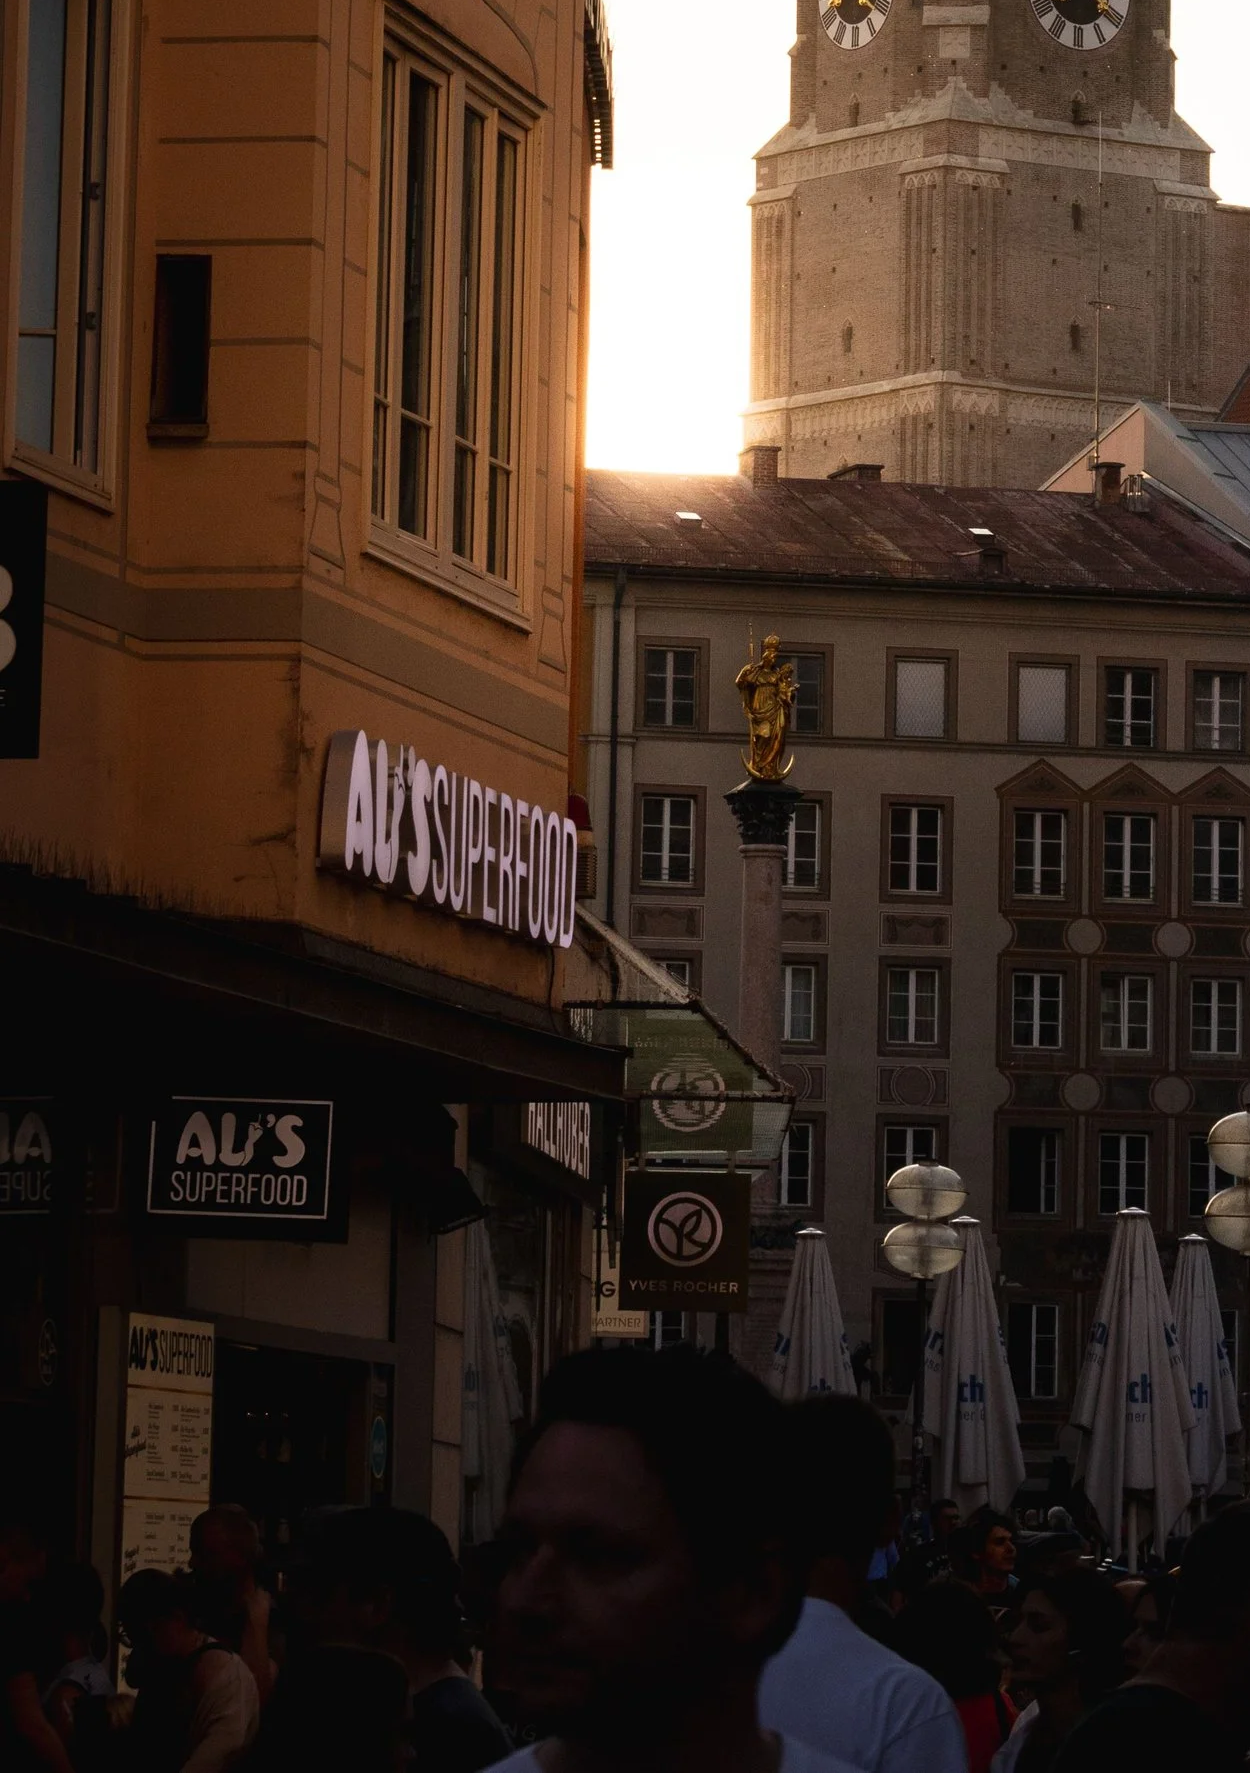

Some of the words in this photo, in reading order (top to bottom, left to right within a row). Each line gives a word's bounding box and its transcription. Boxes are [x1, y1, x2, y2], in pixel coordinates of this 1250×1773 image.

[432, 765, 578, 948] SUPERFOOD
[528, 1102, 590, 1180] HALLHUBER
[169, 1170, 308, 1207] SUPERFOOD
[628, 1279, 668, 1292] YVES
[673, 1280, 739, 1294] ROCHER
[160, 1329, 213, 1378] SUPERFOOD
